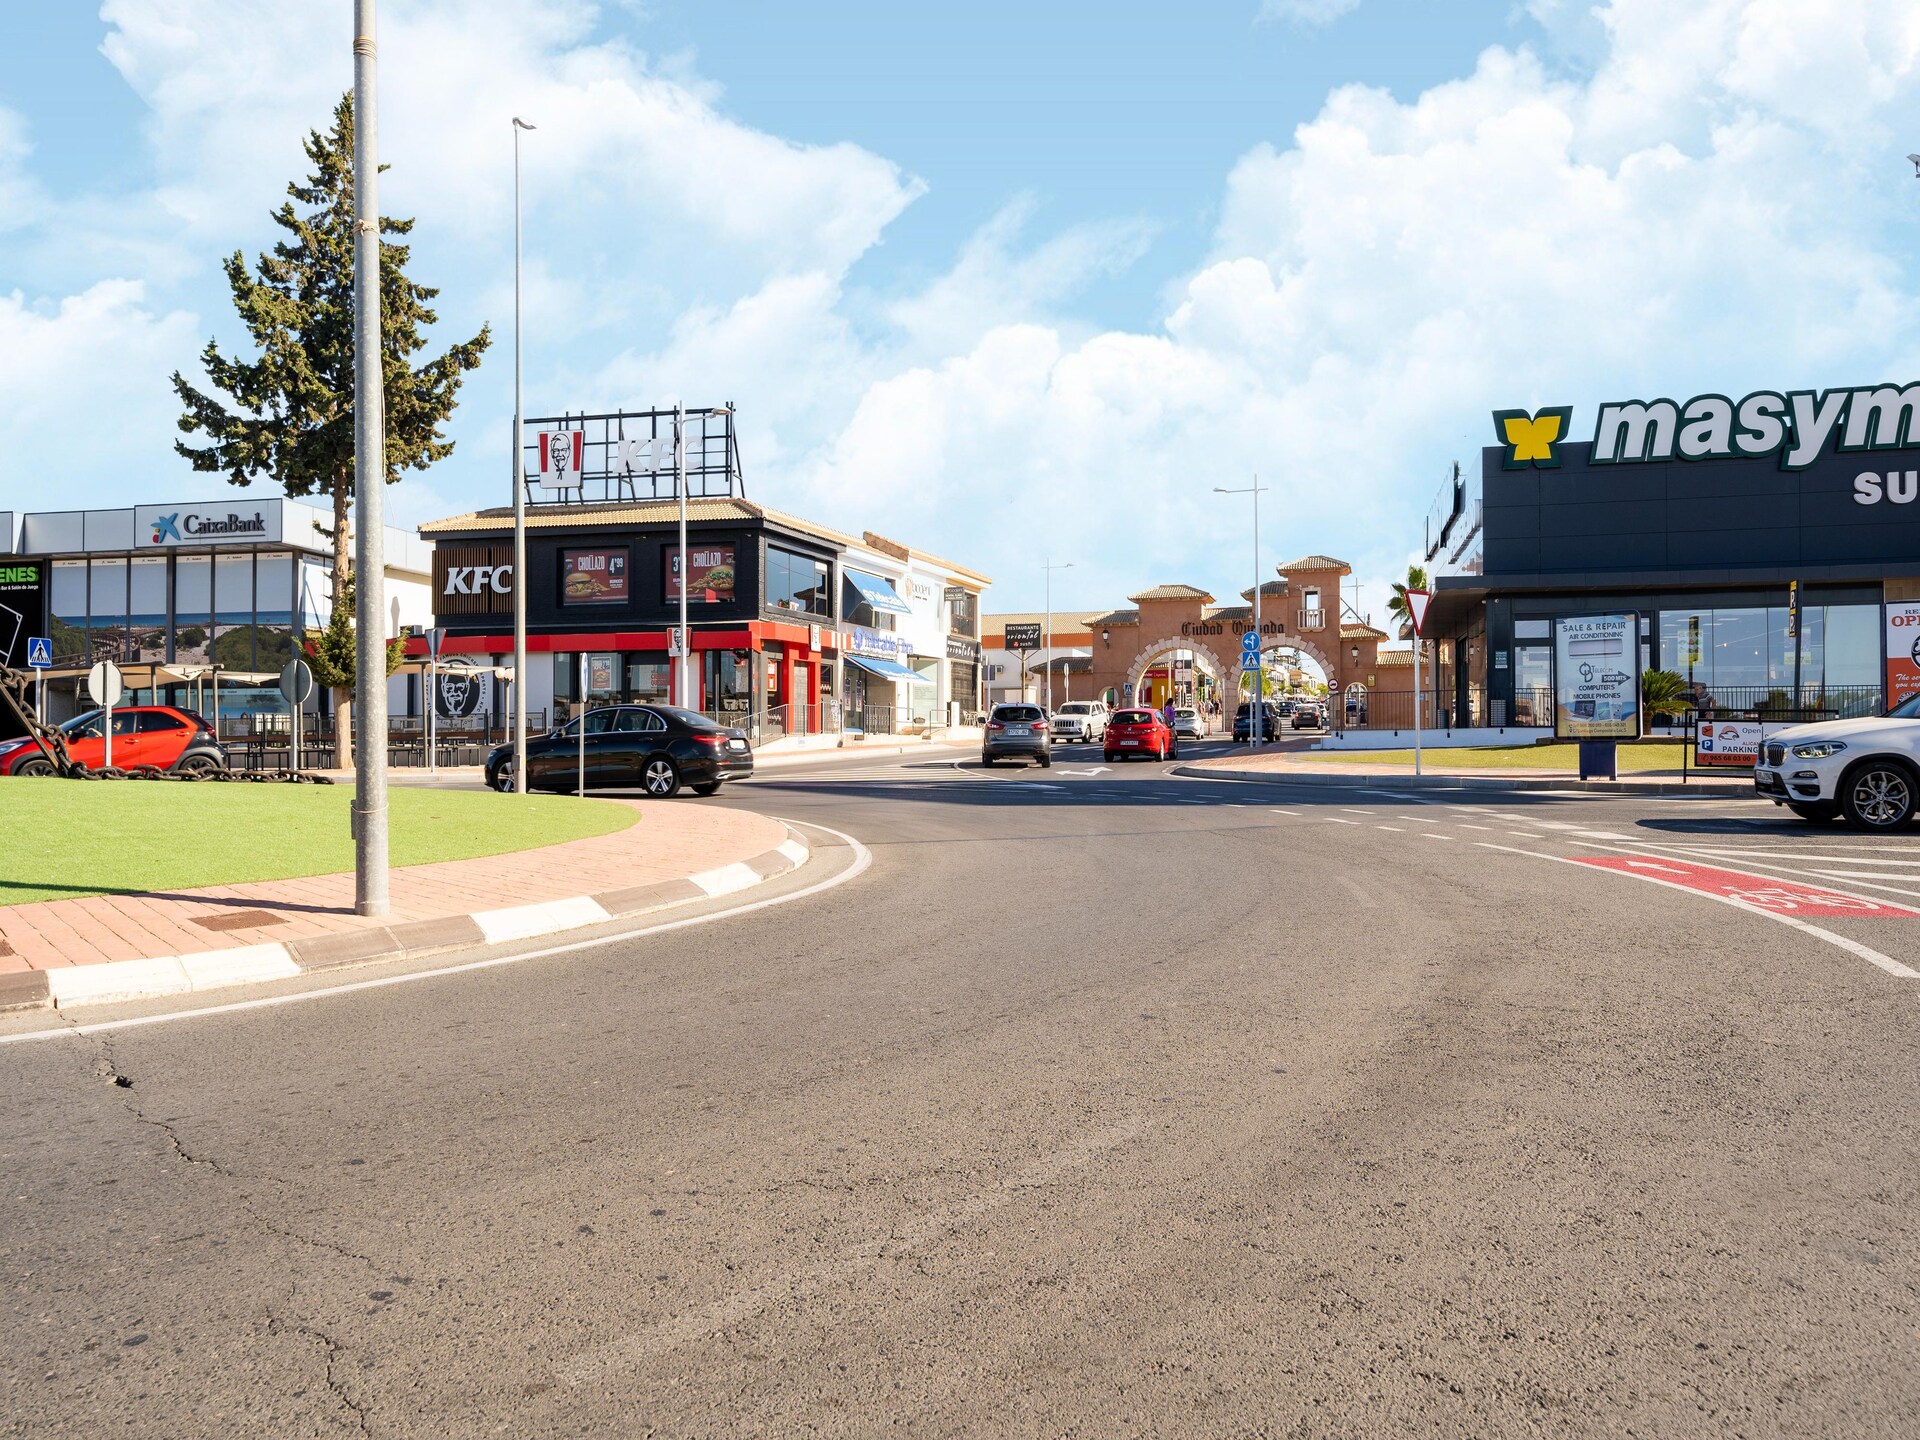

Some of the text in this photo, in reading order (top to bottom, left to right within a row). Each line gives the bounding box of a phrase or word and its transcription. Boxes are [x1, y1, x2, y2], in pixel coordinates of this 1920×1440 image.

[612, 436, 702, 474] KFC
[183, 512, 266, 535] CaixaBank
[443, 564, 513, 595] KFC
[1562, 621, 1626, 632] SALE & REPAIR
[1891, 615, 1920, 627] OP
[1181, 621, 1223, 637] Ciudad
[1580, 631, 1624, 639] CONDITIONING
[1896, 673, 1910, 681] The
[1742, 727, 1761, 735] Open
